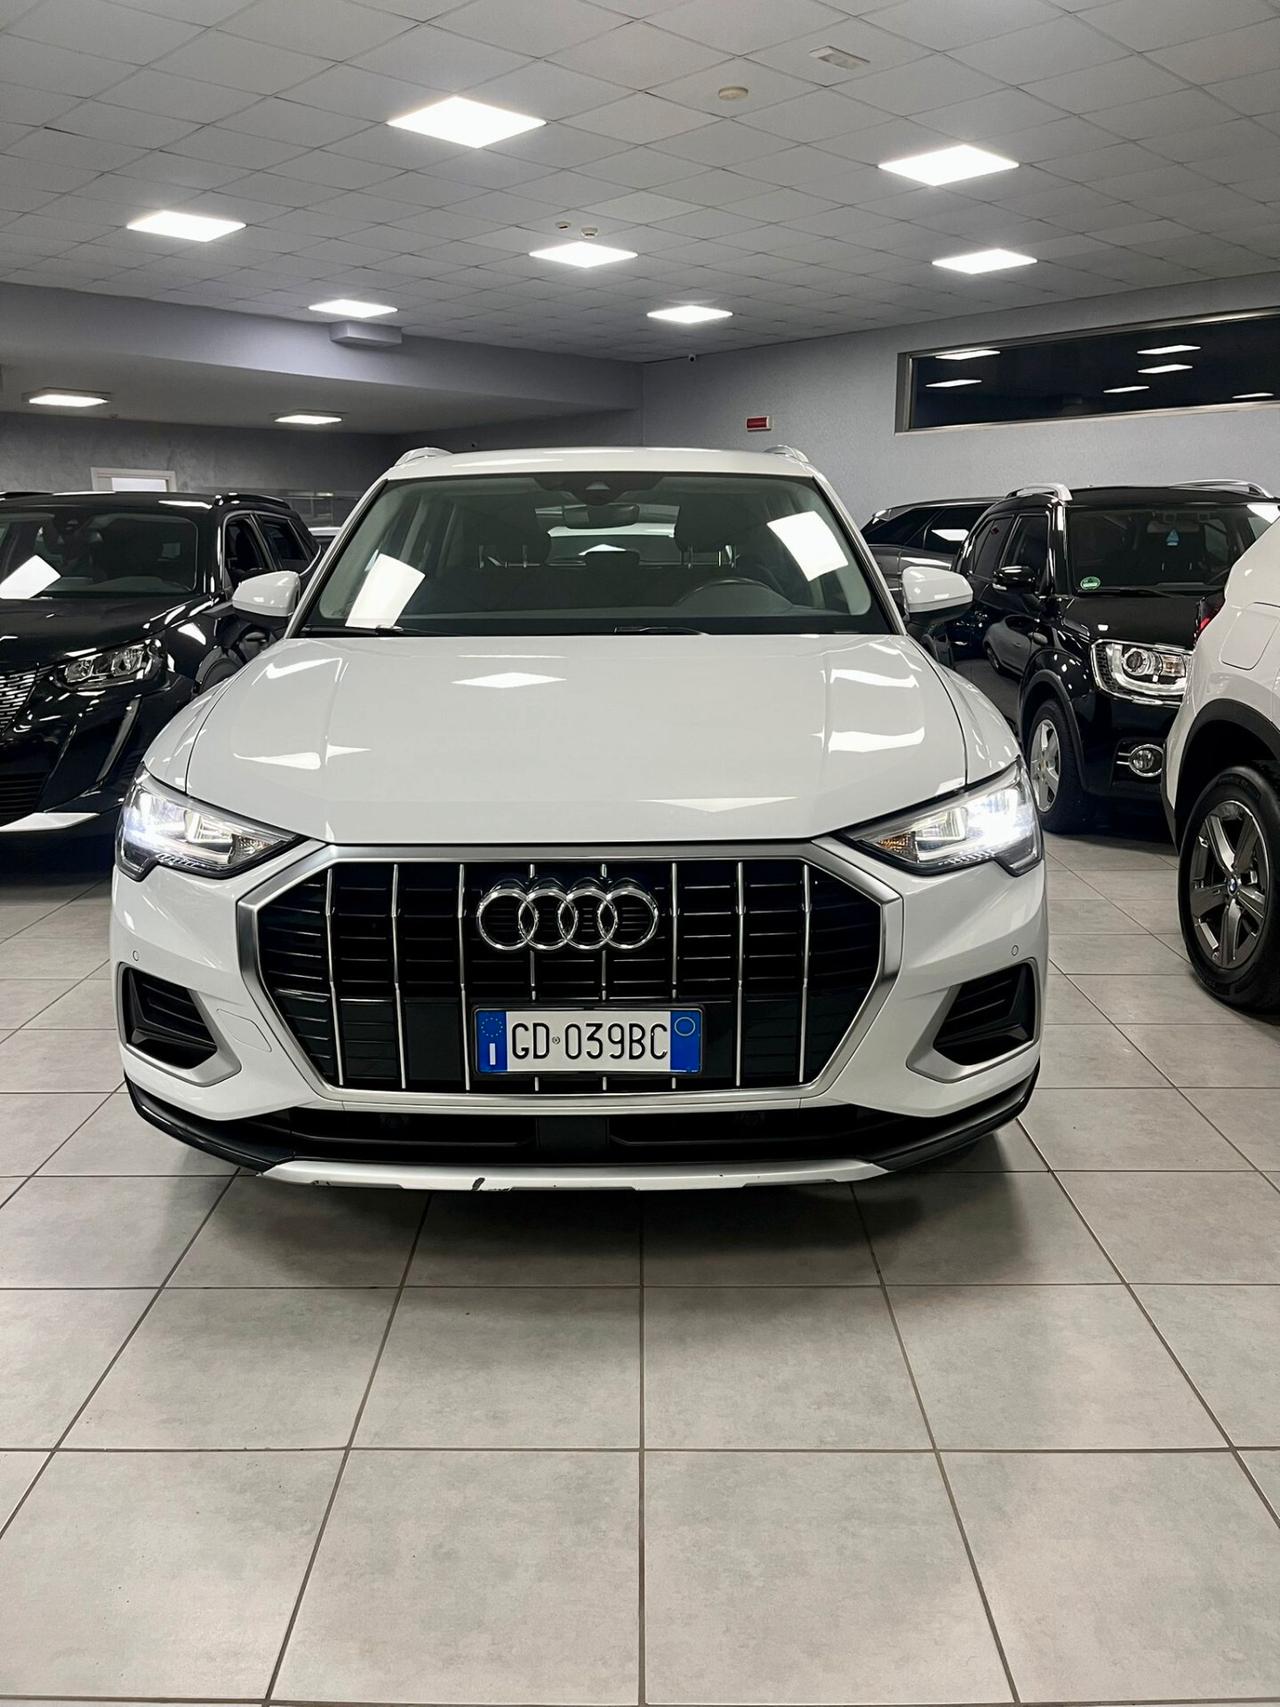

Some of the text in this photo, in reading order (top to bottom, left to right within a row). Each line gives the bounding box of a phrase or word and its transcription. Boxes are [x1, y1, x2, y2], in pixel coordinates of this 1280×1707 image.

[489, 1043, 496, 1065] I
[511, 1022, 668, 1060] GD 039BC
